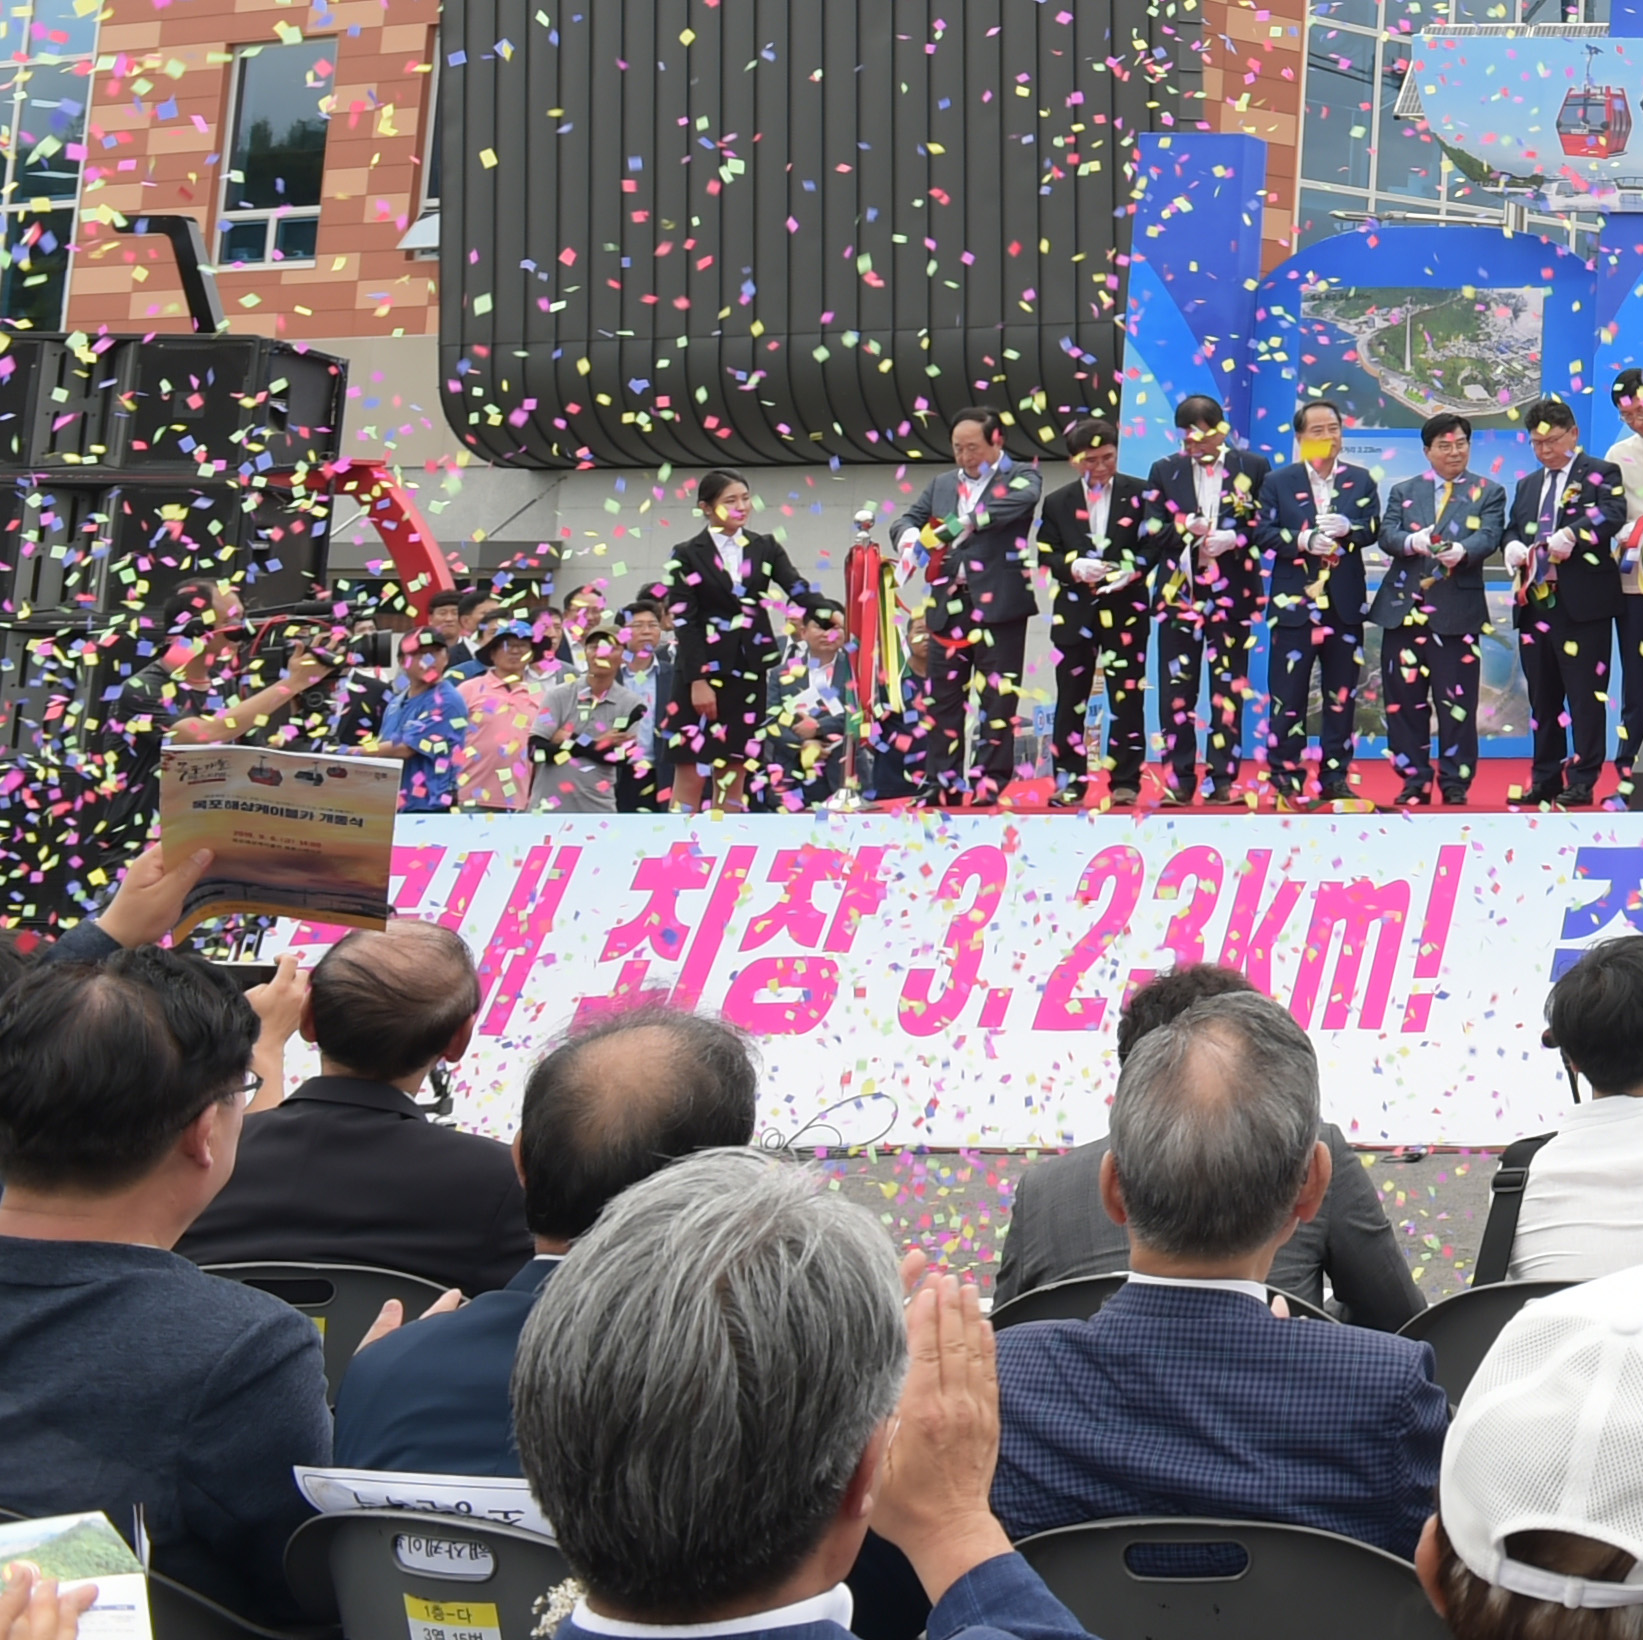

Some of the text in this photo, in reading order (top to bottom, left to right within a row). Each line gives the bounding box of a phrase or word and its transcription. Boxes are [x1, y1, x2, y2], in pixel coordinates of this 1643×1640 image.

[192, 799, 363, 828] 목포해상케이블카 개통식
[897, 844, 1467, 1037] 3.23km!
[423, 1605, 472, 1624] 1층-다
